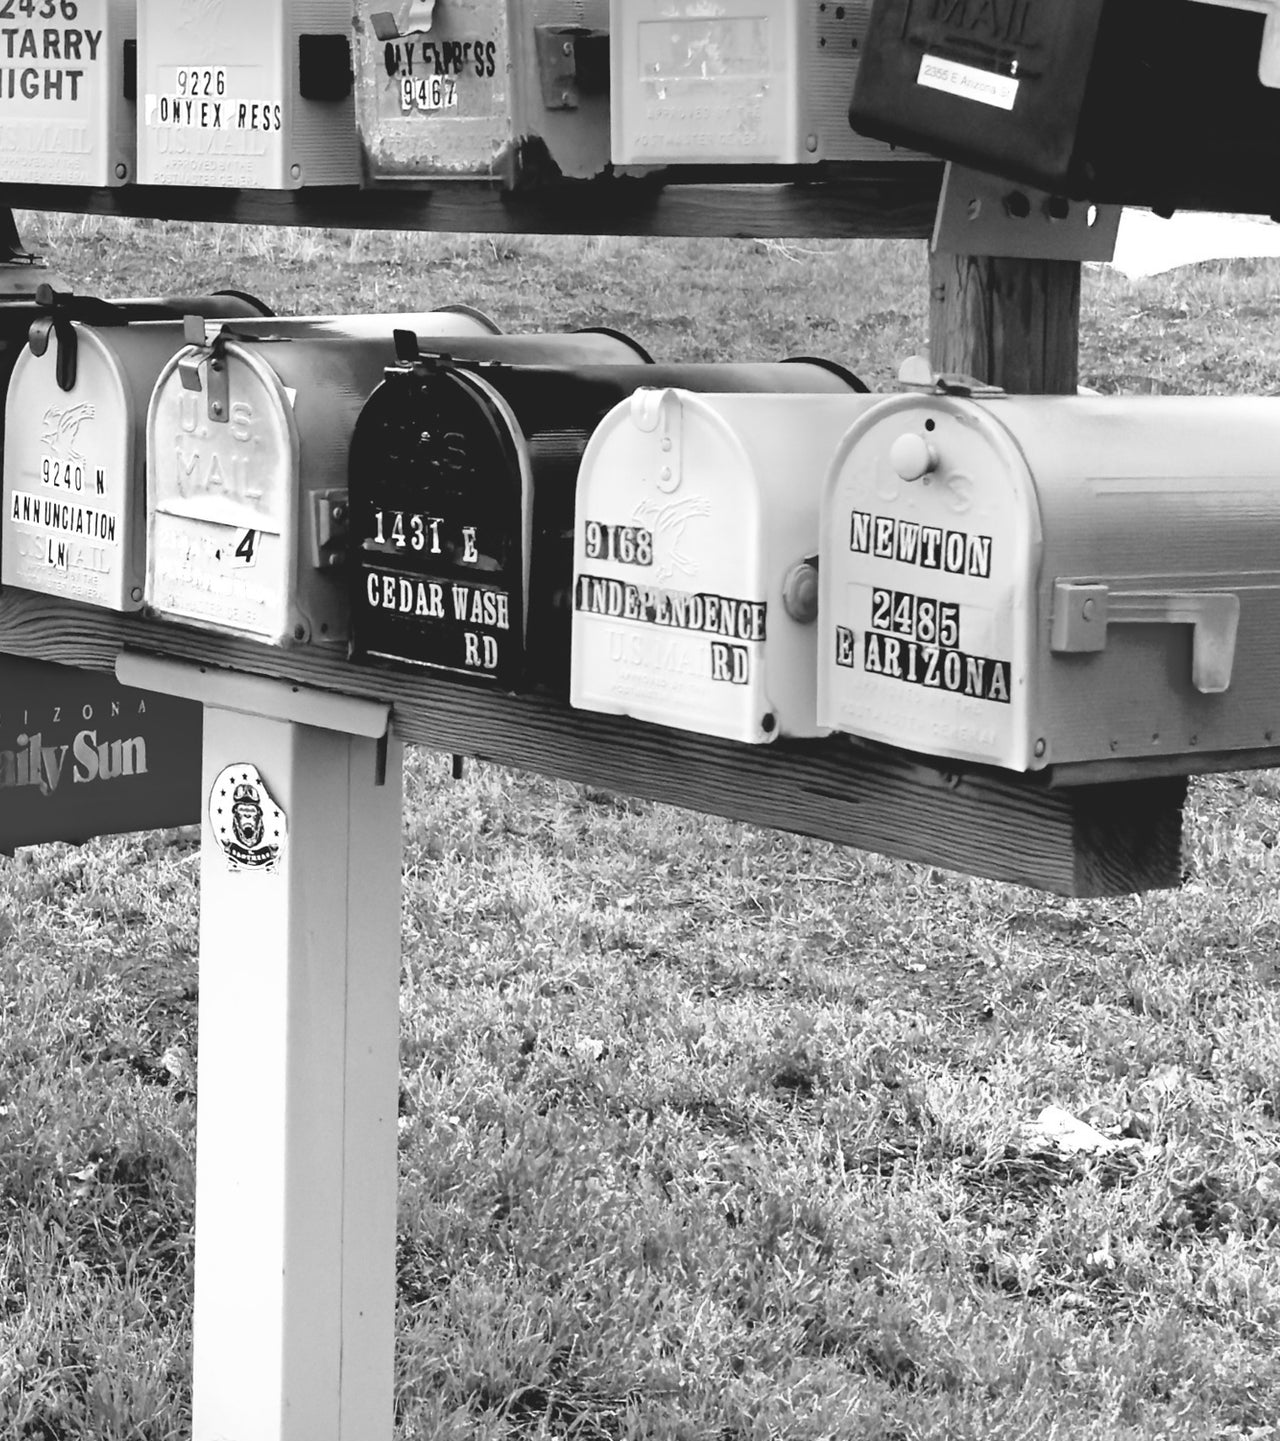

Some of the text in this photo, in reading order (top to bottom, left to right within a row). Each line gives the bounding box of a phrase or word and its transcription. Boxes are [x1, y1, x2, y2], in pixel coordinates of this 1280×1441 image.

[178, 70, 224, 96] 9226
[404, 79, 456, 106] 9467
[43, 458, 105, 495] 9240 N
[175, 448, 264, 502] MAIL
[13, 494, 116, 542] ANNUNCIATION
[373, 510, 478, 564] 1431 E
[48, 538, 66, 567] LN
[235, 529, 255, 563] 4
[587, 521, 653, 566] 9168
[851, 511, 992, 578] NEWTON
[367, 571, 510, 631] CEDAR WASH
[578, 576, 767, 641] INDEPENDENCE
[872, 589, 958, 648] 2485
[464, 631, 498, 670] RD
[712, 643, 748, 684] RD
[837, 627, 854, 669] E
[865, 633, 1011, 703] ARIZONA
[72, 729, 149, 785] Sun
